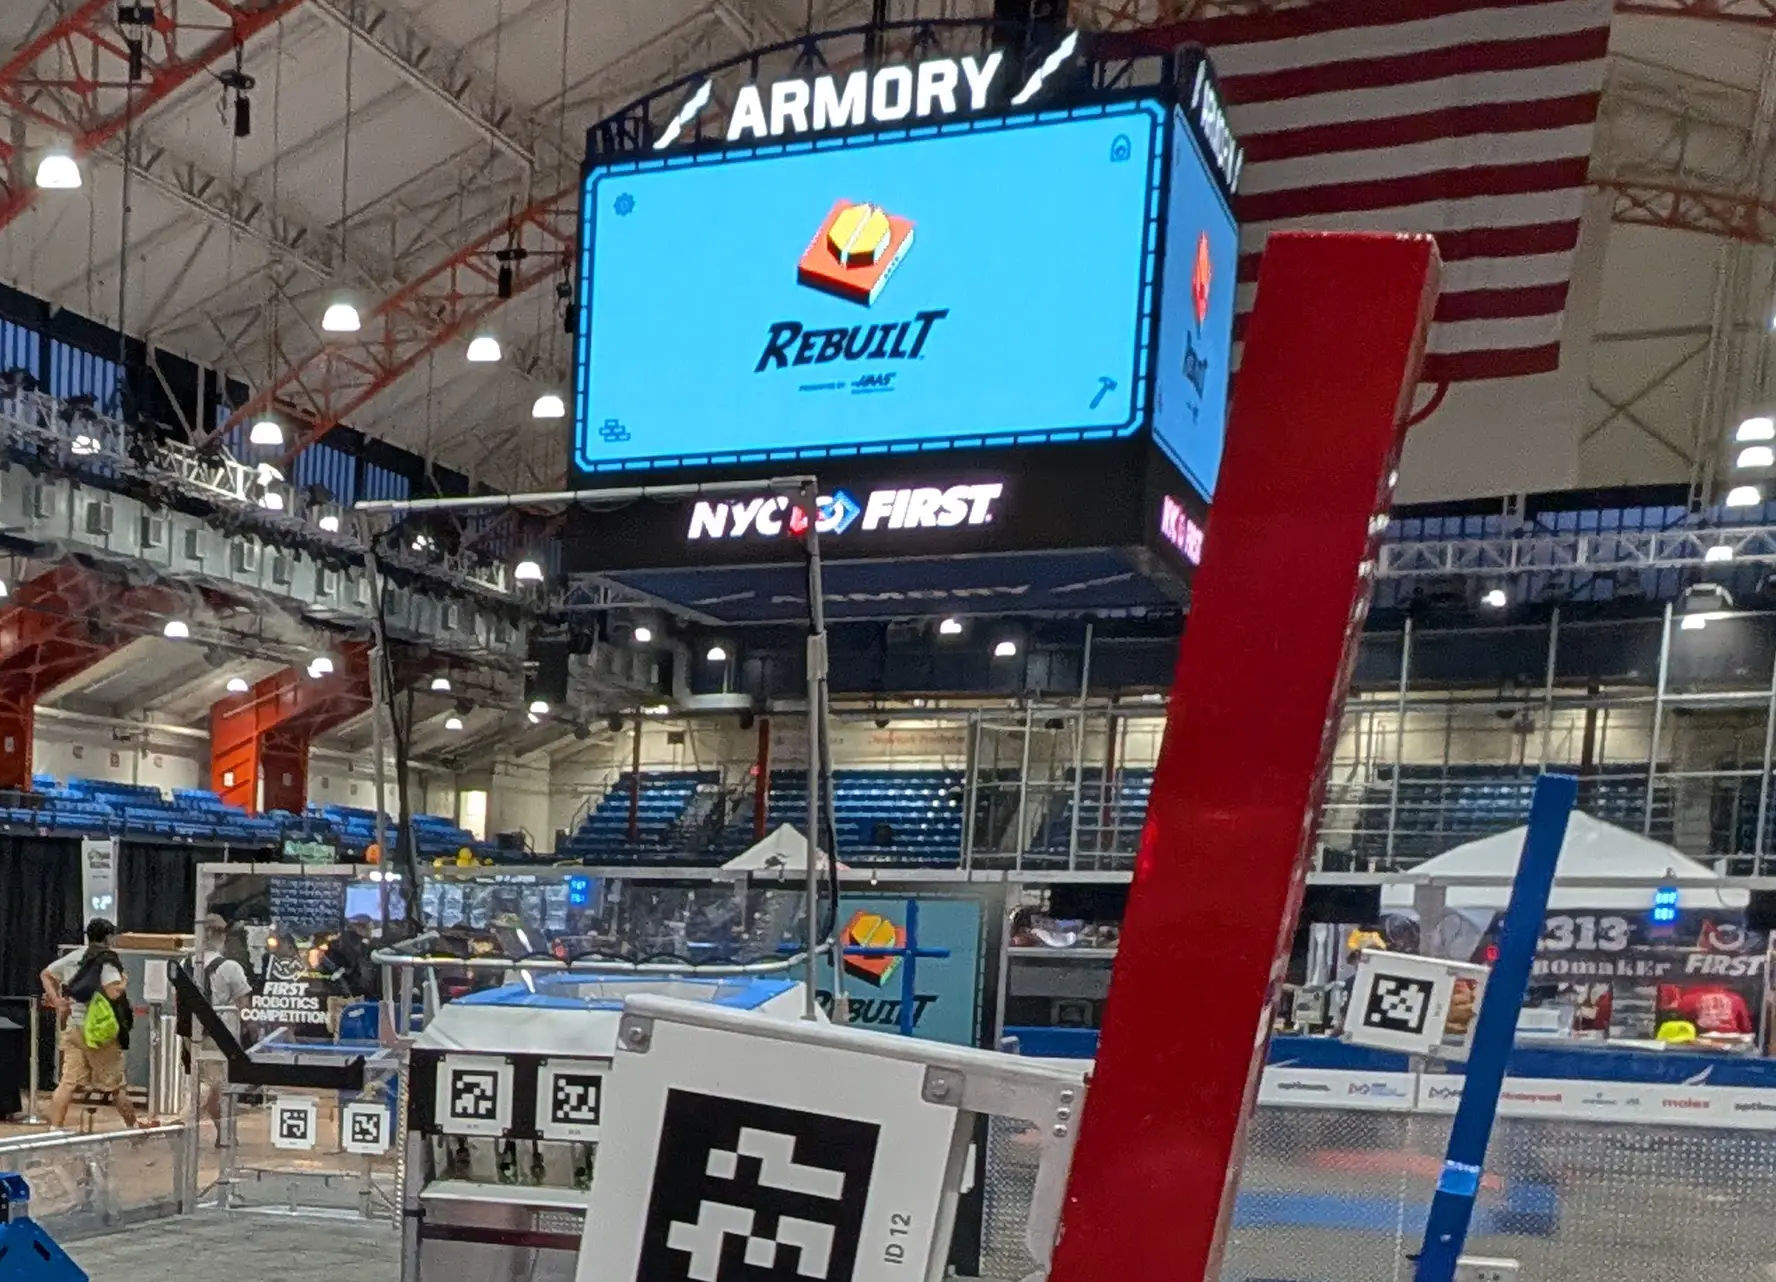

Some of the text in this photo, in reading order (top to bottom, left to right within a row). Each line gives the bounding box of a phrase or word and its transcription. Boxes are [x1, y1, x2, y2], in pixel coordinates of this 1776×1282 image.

[727, 52, 1004, 141] ARMORY
[754, 309, 949, 373] REBUILT
[688, 484, 1003, 540] NYC FIRST
[1685, 953, 1767, 976] FIRST
[251, 995, 320, 1010] ROBOTICS
[263, 981, 310, 996] FIRST
[240, 1007, 332, 1025] COMPETITION
[884, 1213, 911, 1264] ID 12
